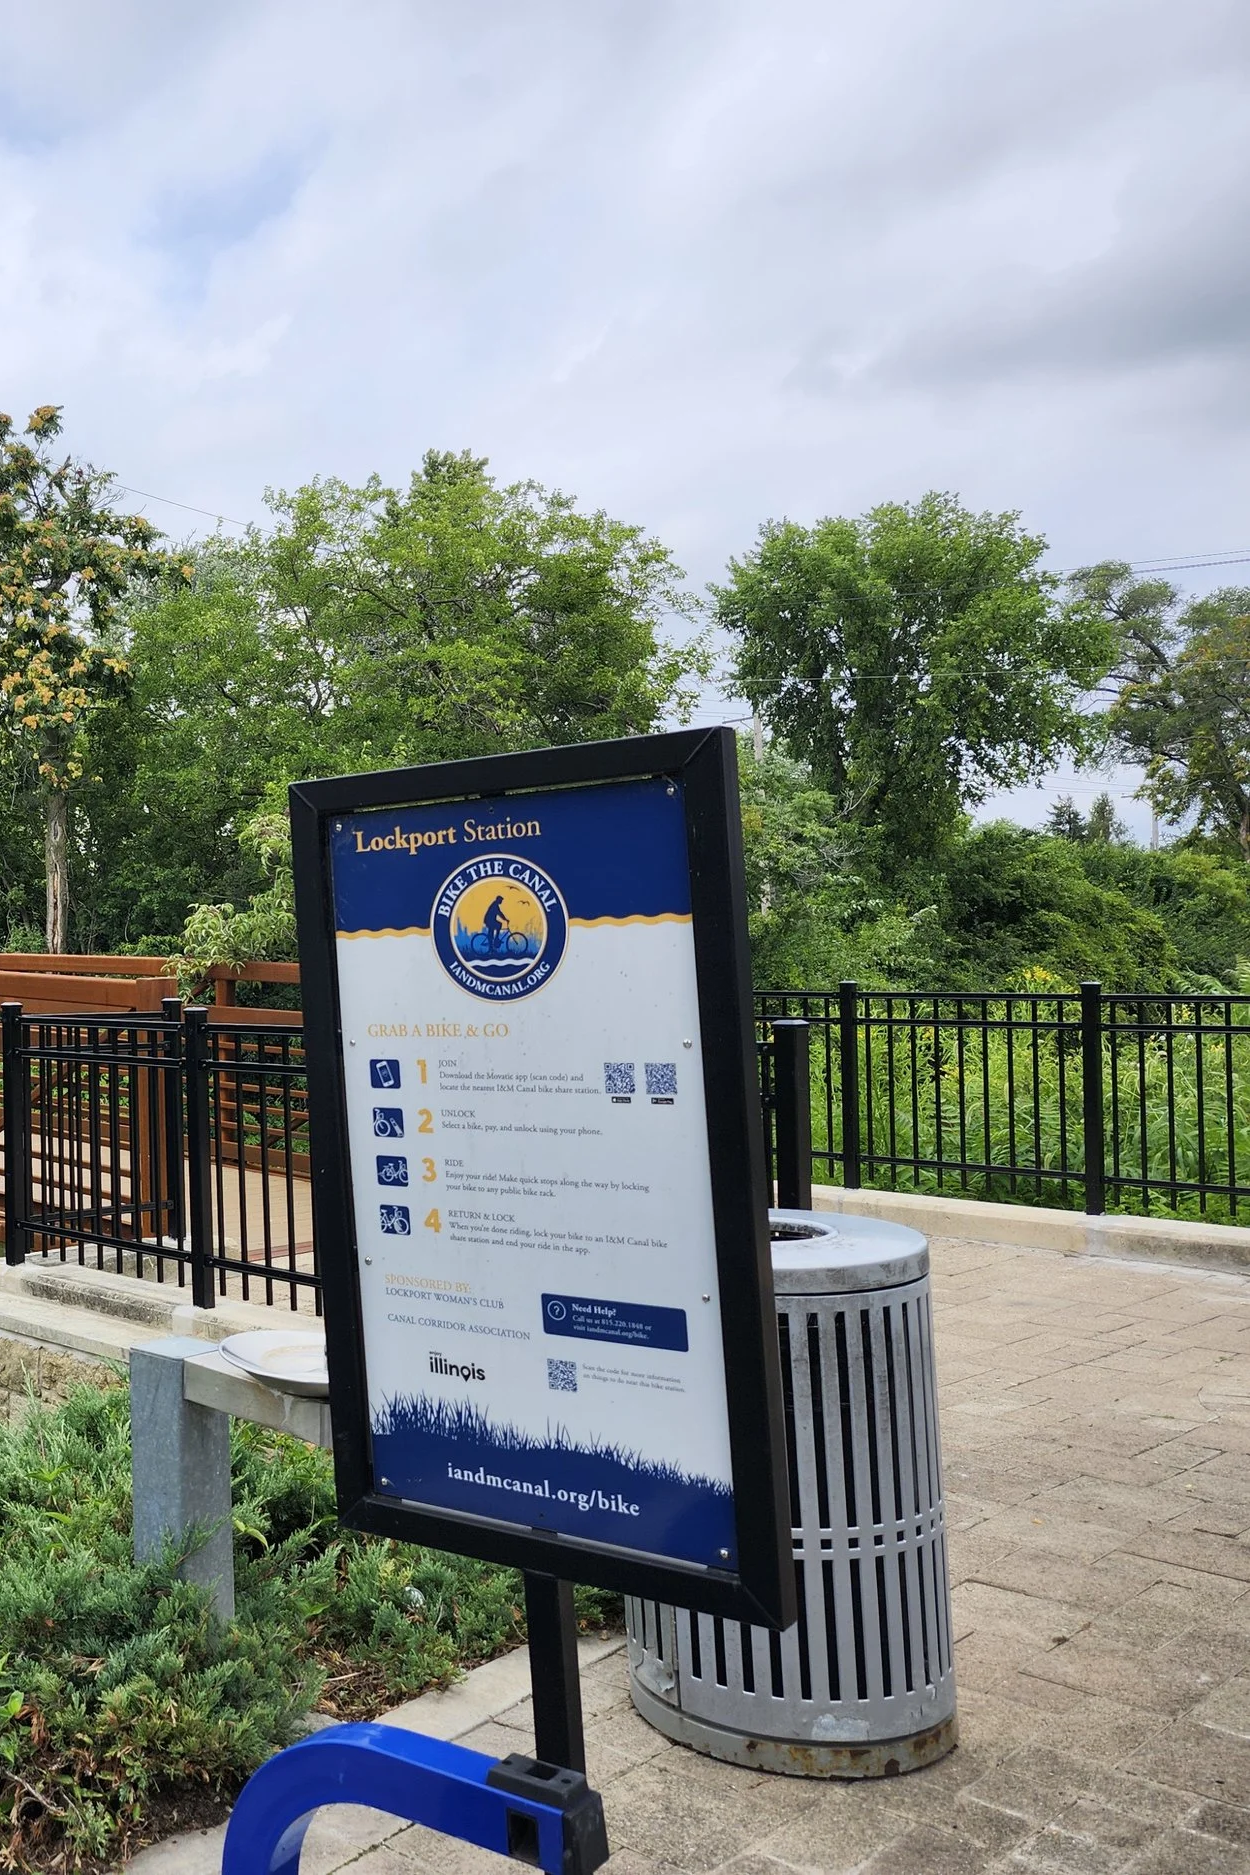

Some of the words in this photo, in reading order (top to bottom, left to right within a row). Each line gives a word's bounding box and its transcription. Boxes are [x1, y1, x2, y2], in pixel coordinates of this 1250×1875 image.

[354, 826, 457, 855] Lockport
[464, 817, 541, 842] Station
[438, 876, 468, 917] BIKE
[466, 861, 504, 881] THE
[509, 864, 557, 912] CANAL
[449, 961, 550, 996] IANDMCANAL.ORG
[368, 1024, 408, 1037] GRAB
[412, 1024, 422, 1037] A
[426, 1024, 461, 1037] BIKE
[466, 1024, 479, 1037] &
[483, 1023, 509, 1037] GO
[417, 1059, 427, 1084] 1
[438, 1060, 457, 1068] JOIN
[439, 1071, 472, 1079] Download
[474, 1072, 485, 1080] the
[486, 1072, 513, 1080] Movatic
[515, 1074, 528, 1082] app
[530, 1073, 547, 1081] (scan
[550, 1073, 568, 1081] code)
[439, 1082, 458, 1090] locate
[460, 1083, 470, 1091] the
[496, 1084, 514, 1092] I&M
[538, 1085, 553, 1093] bike
[418, 1108, 434, 1134] 2
[441, 1109, 475, 1118] UNLOCK
[442, 1121, 460, 1129] Select
[467, 1122, 483, 1130] bike,
[500, 1123, 512, 1131] and
[514, 1124, 538, 1132] unlock
[540, 1125, 558, 1135] using
[560, 1127, 576, 1135] your
[578, 1126, 603, 1136] phone.
[421, 1157, 437, 1182] 3
[444, 1159, 464, 1167] RIDE
[446, 1171, 464, 1180] Enjoy
[466, 1173, 480, 1181] your
[482, 1173, 497, 1181] ride!
[498, 1174, 518, 1182] Make
[520, 1175, 539, 1184] quick
[560, 1178, 579, 1188] along
[581, 1178, 592, 1187] the
[594, 1181, 609, 1190] way
[610, 1180, 620, 1191] by
[621, 1181, 650, 1193] locking
[462, 1183, 476, 1191] bike
[486, 1187, 499, 1195] any
[500, 1186, 521, 1195] public
[523, 1187, 537, 1196] bike
[539, 1189, 556, 1197] rack.
[424, 1208, 442, 1233] 4
[448, 1210, 481, 1220] RETURN
[492, 1213, 515, 1222] LOCK
[449, 1221, 469, 1230] When
[470, 1224, 489, 1232] you're
[491, 1225, 508, 1234] done
[509, 1227, 531, 1238] riding,
[533, 1229, 548, 1237] lock
[550, 1232, 566, 1240] your
[568, 1232, 583, 1240] bike
[606, 1235, 625, 1245] I&M
[627, 1237, 649, 1247] Canal
[651, 1239, 668, 1248] bike
[450, 1233, 466, 1241] share
[468, 1236, 490, 1244] station
[491, 1238, 504, 1246] and
[505, 1239, 518, 1247] end
[537, 1242, 550, 1250] ride
[552, 1243, 560, 1251] in
[562, 1243, 573, 1252] the
[575, 1247, 591, 1255] app.
[385, 1273, 451, 1290] SPONSORED
[385, 1287, 432, 1301] LOCKPORT
[433, 1292, 478, 1306] WOMAN'S
[479, 1298, 504, 1309] CLUB
[572, 1303, 592, 1313] Need
[593, 1306, 616, 1318] Help?
[387, 1313, 416, 1325] CANAL
[418, 1317, 467, 1332] CORRIDOR
[468, 1324, 530, 1340] ASSOCIATION
[430, 1356, 486, 1382] illinois
[447, 1462, 641, 1517] iandmcanal.org/bike
